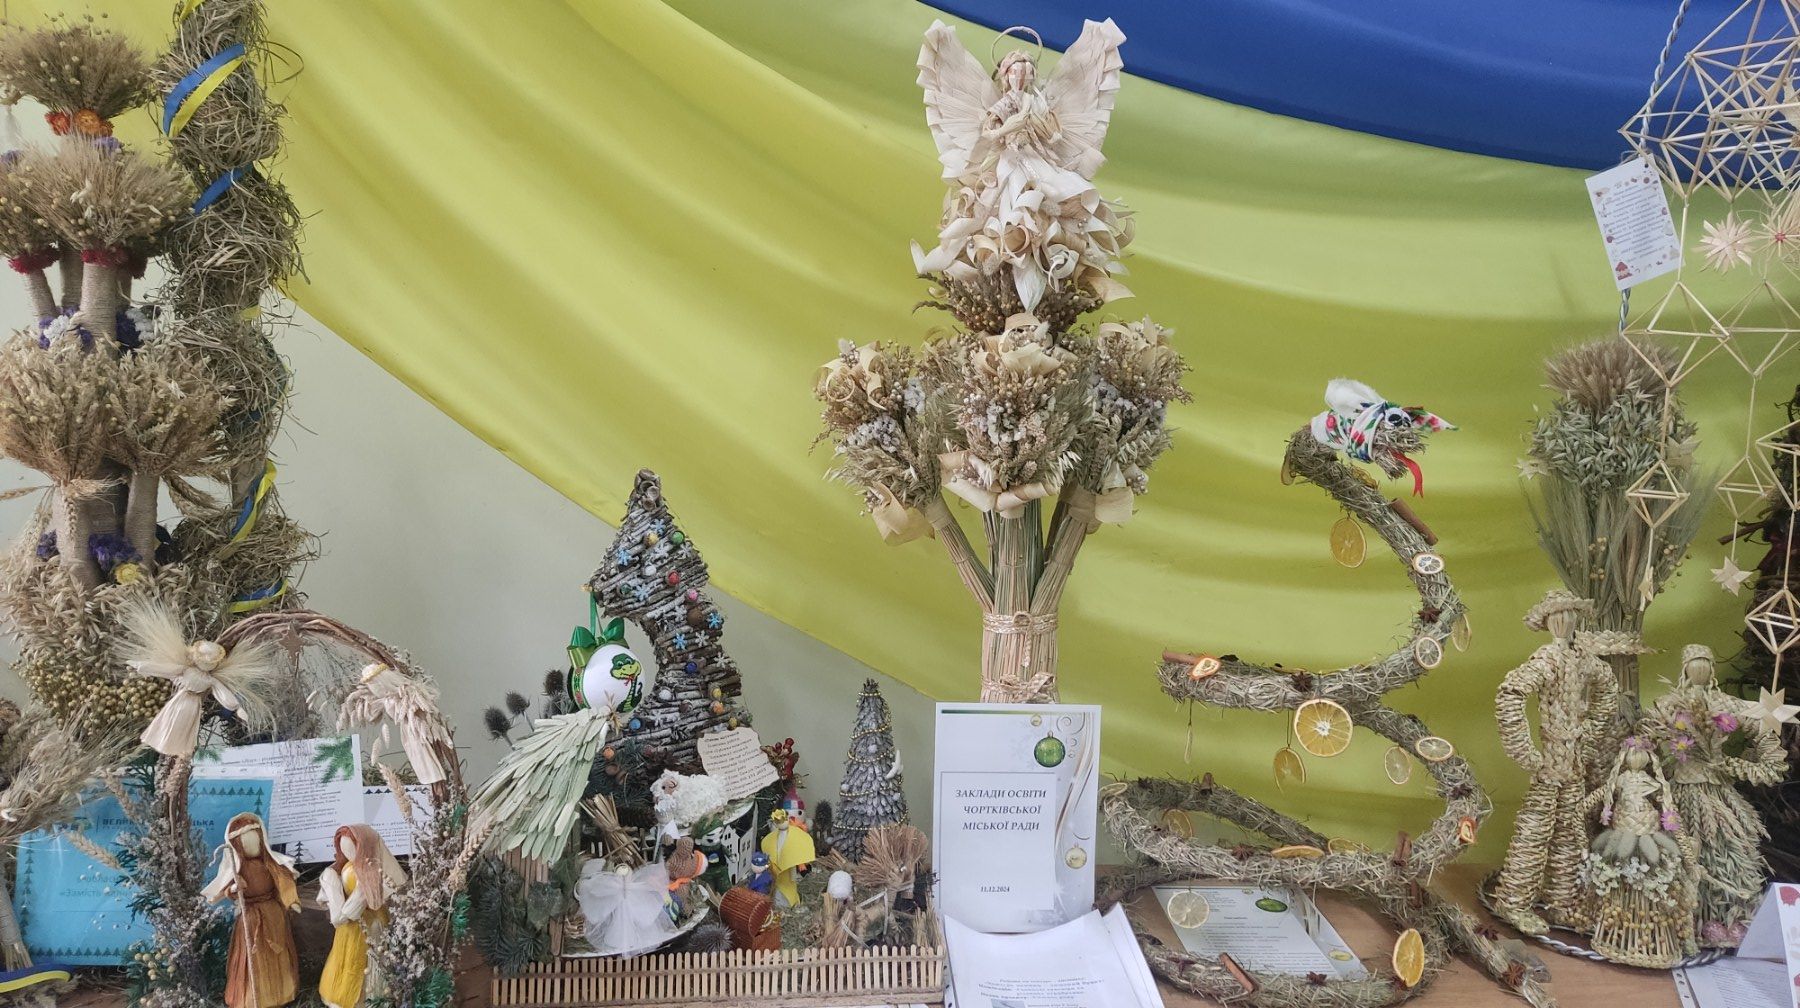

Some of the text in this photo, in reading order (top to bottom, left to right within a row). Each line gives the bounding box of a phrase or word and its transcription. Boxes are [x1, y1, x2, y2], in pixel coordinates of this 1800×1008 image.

[955, 789, 1046, 799] ЗАКЛАДИ ОСВІТИ
[963, 804, 1041, 814] ЧОРТКІВСЬКОЇ
[962, 820, 1040, 831] МІСЬКОЇ РАДИ
